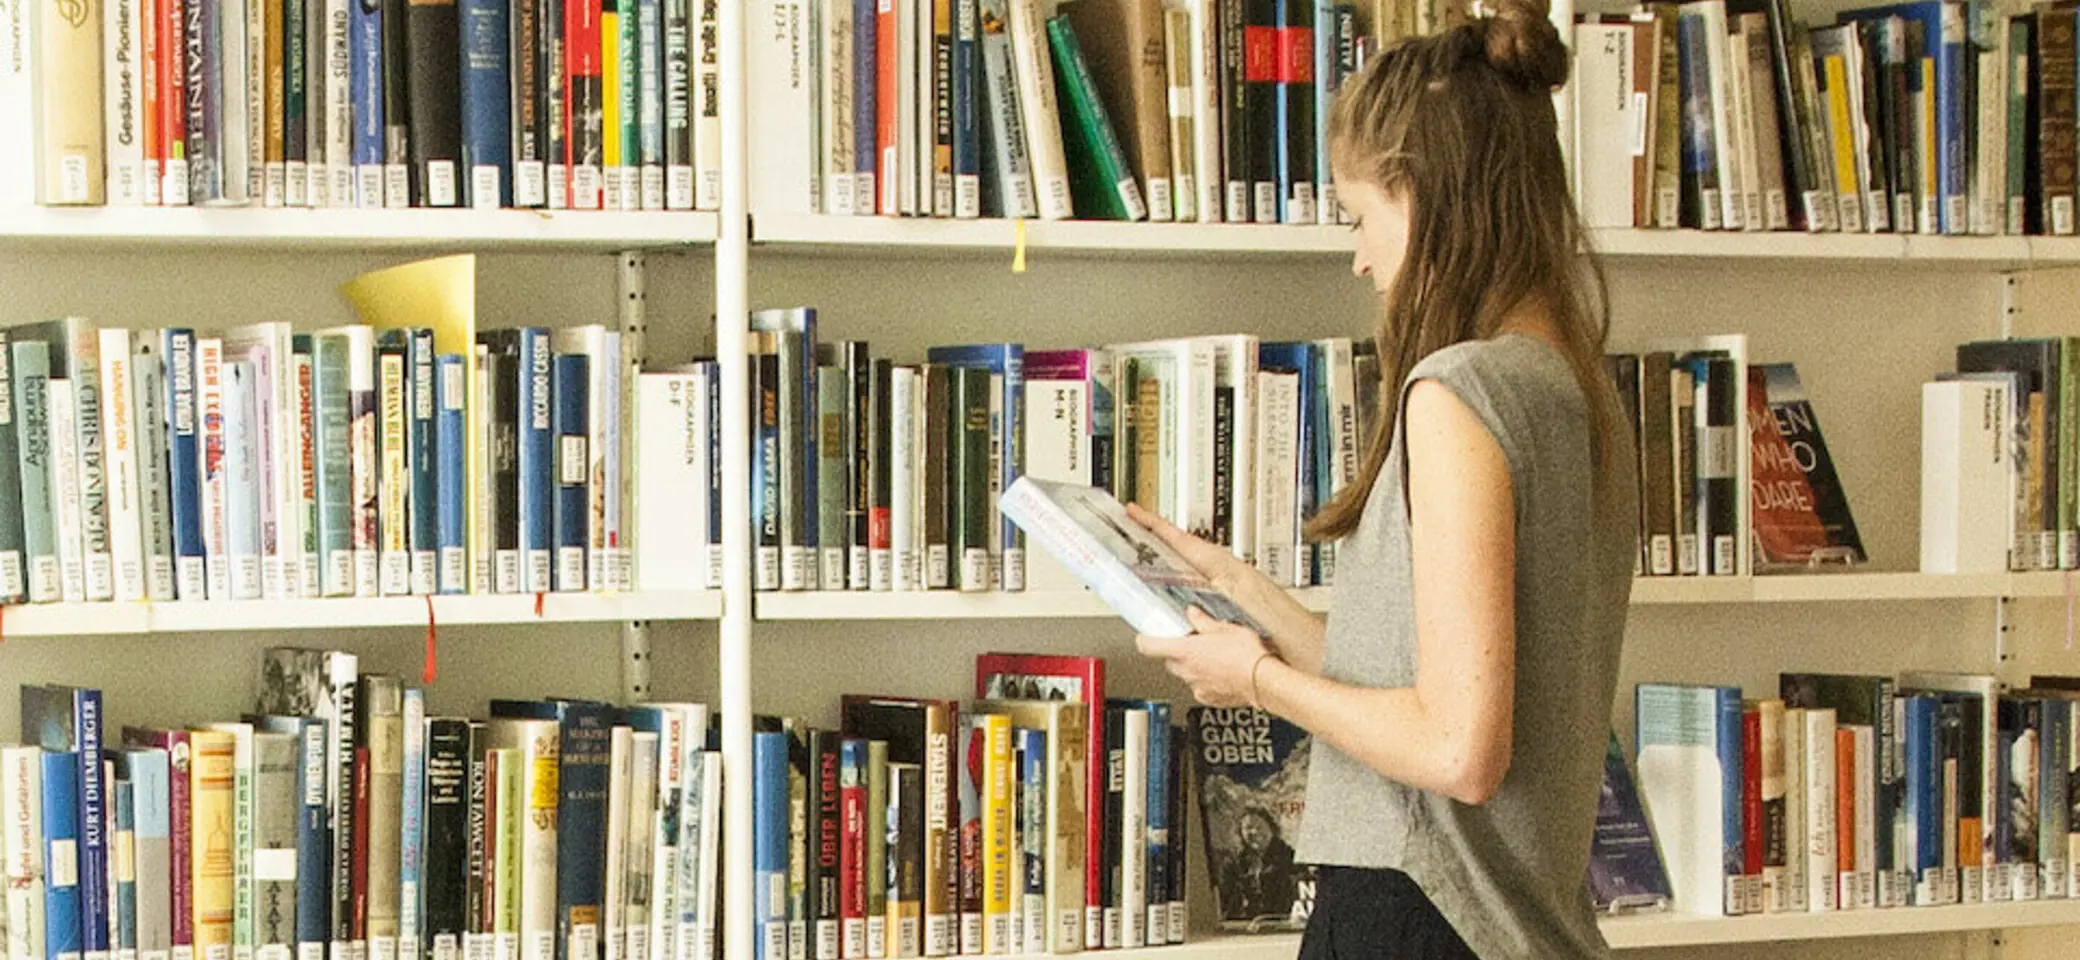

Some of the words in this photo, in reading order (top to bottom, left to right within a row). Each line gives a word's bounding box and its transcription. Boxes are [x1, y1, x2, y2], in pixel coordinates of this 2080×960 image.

[331, 10, 348, 78] SÜDWAND
[669, 25, 687, 54] THE
[790, 3, 801, 89] BIOGRAPHIEN
[1340, 12, 1354, 67] ALLEN
[669, 59, 687, 129] CALLING
[1617, 31, 1627, 111] BIOGRAPHIEN
[186, 0, 204, 192] NTAINEERS
[203, 347, 217, 386] HIGH
[79, 384, 99, 445] CHRIS
[112, 359, 126, 424] HANGING
[669, 380, 681, 406] D-F
[1054, 388, 1066, 420] M-N
[1278, 383, 1290, 425] INTO
[115, 429, 127, 451] ON
[685, 380, 695, 465] BIOGRAPHIEN
[1070, 388, 1079, 472] BIOGRAPHIEN
[1266, 389, 1276, 456] SILENCE
[1339, 404, 1351, 434] mir
[1749, 403, 1814, 435] MEN
[1994, 387, 2002, 464] BIOGRAPHIEN
[764, 437, 776, 485] LAMA
[1277, 430, 1290, 462] THE
[1339, 437, 1352, 453] in
[1753, 441, 1817, 473] WHO
[82, 450, 106, 553] BONINGTO
[764, 485, 776, 535] DAVID
[1752, 480, 1813, 512] DARE
[340, 685, 354, 765] HIMALA
[1199, 707, 1270, 727] AUCH
[1202, 726, 1273, 745] GANZ
[84, 700, 98, 801] DIEMBERGER
[1203, 745, 1275, 764] OBEN
[16, 757, 30, 822] Gefährten
[472, 761, 485, 800] RON
[821, 752, 835, 812] LEBEN
[930, 733, 948, 831] STATEMENT
[86, 804, 99, 847] KURT
[1277, 801, 1305, 814] FR
[19, 823, 31, 850] und
[471, 803, 484, 878] FAWCETT
[817, 819, 836, 867] ÜBER
